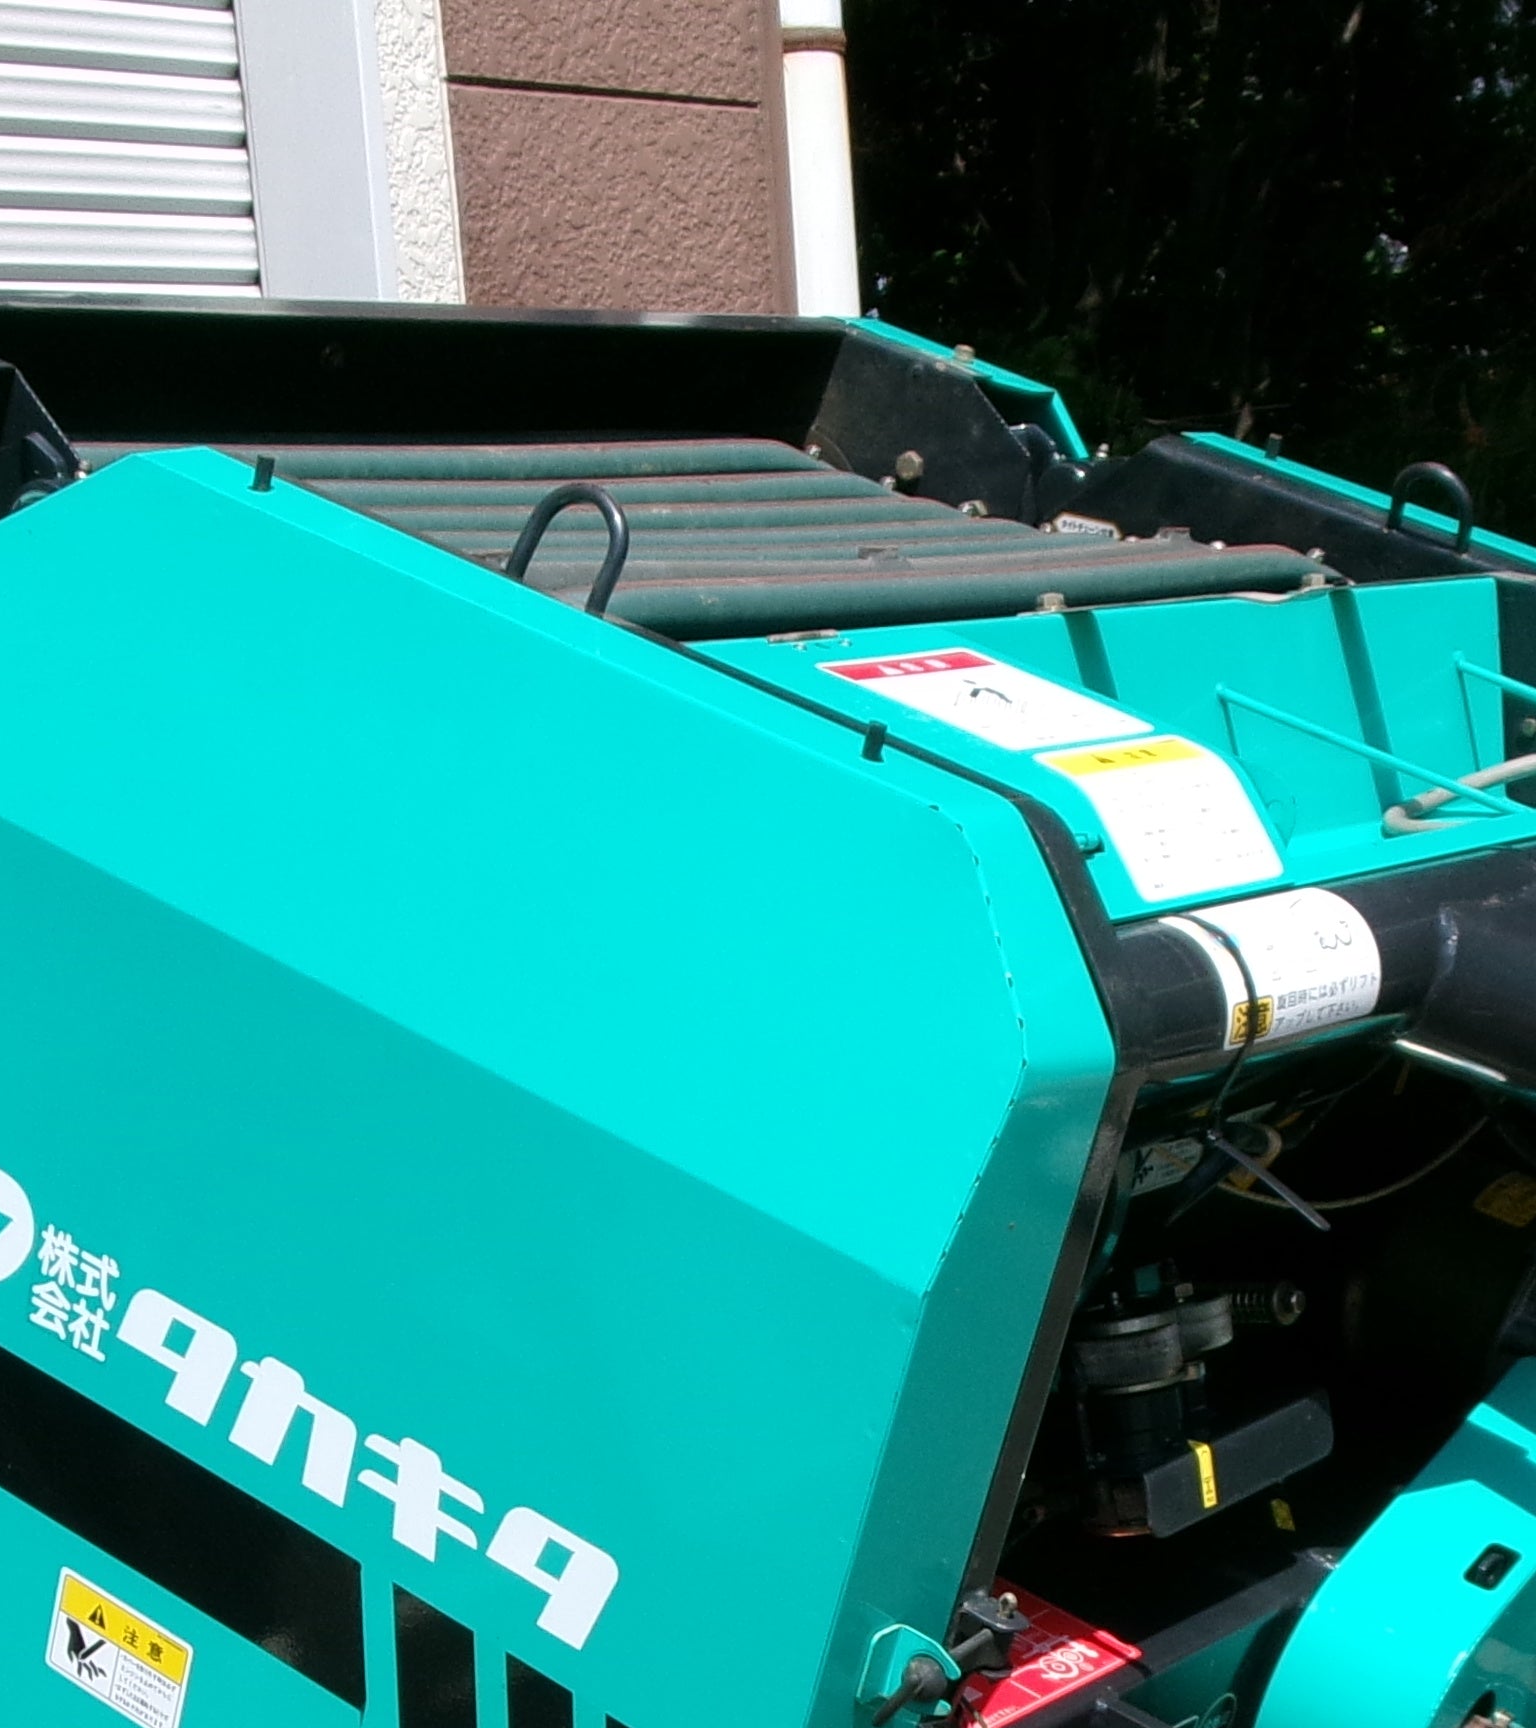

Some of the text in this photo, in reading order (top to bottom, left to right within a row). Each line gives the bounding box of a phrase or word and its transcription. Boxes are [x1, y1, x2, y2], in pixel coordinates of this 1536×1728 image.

[38, 1223, 120, 1312] 株式
[29, 1280, 110, 1362] 会社
[116, 1287, 620, 1651] タカキタ
[122, 1625, 164, 1664] 注意
